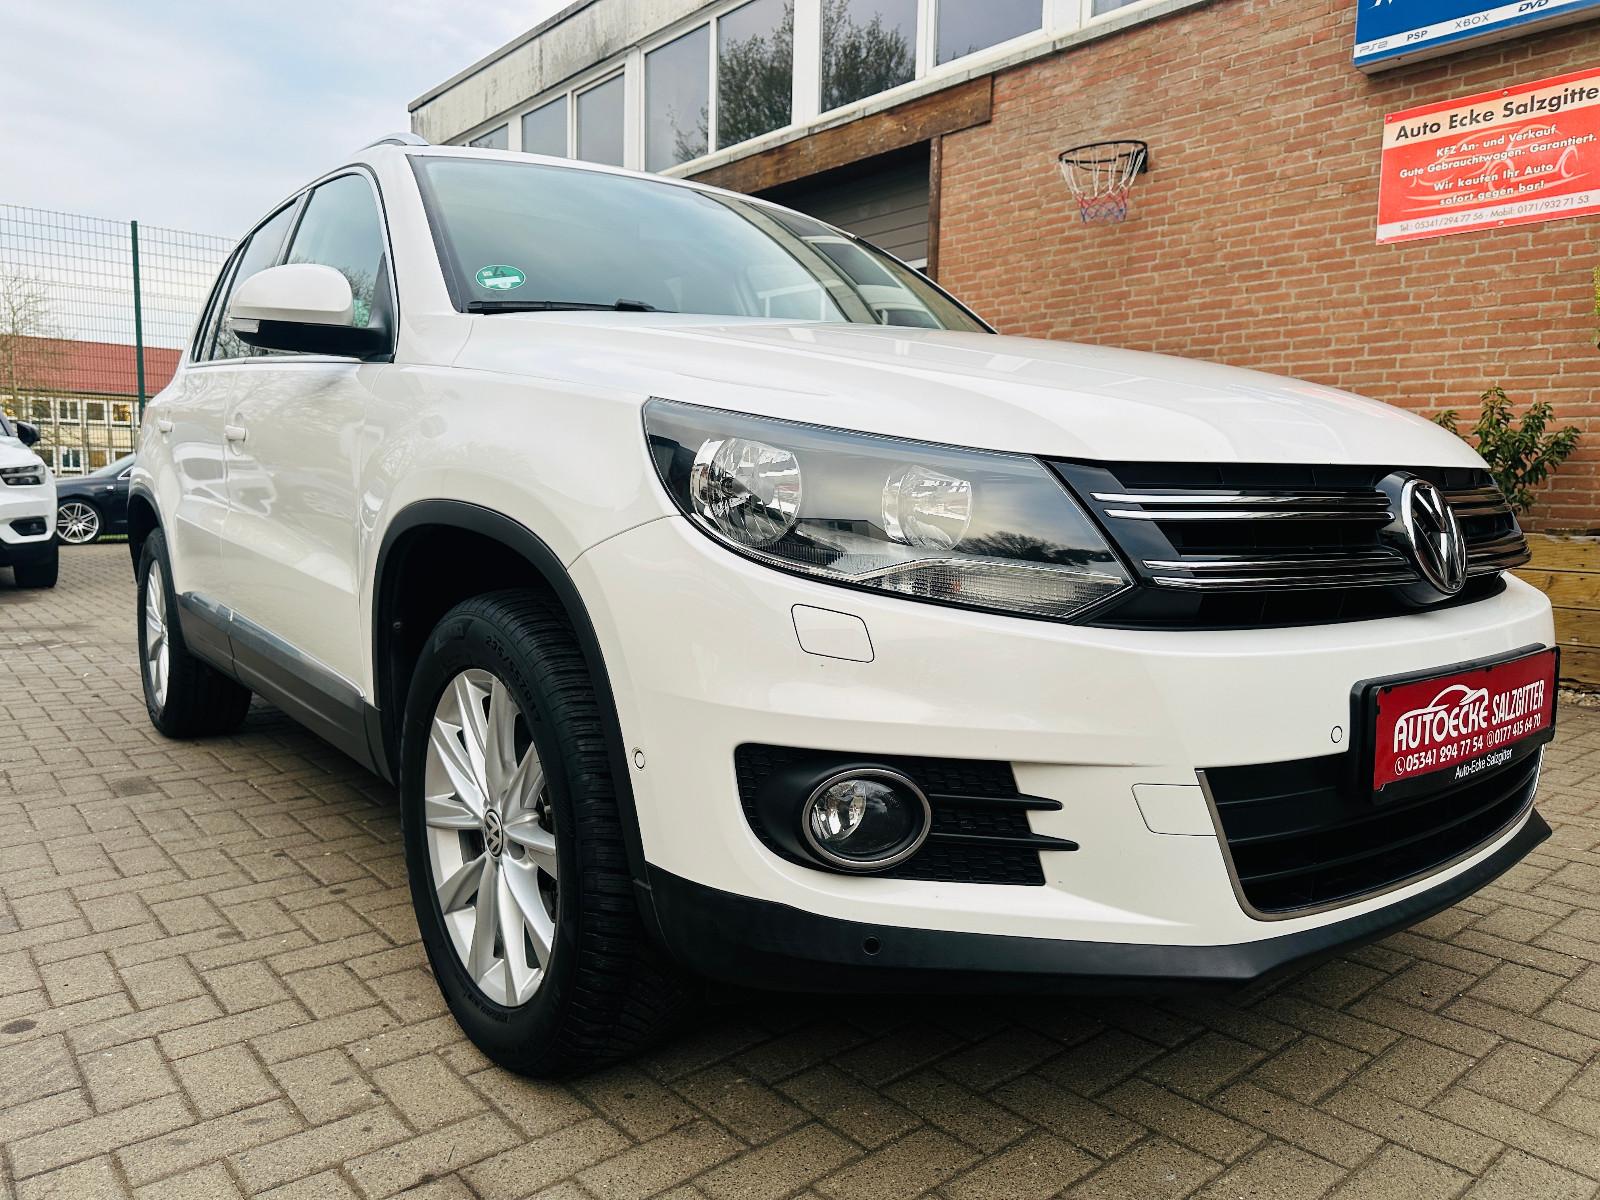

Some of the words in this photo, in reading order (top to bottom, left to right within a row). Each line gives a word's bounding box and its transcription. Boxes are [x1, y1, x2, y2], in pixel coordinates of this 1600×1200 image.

[1360, 40, 1388, 54] PS2
[1406, 30, 1428, 42] PSP
[1454, 13, 1490, 30] XBOX
[1518, 0, 1549, 12] DVD
[1395, 122, 1440, 141] Auto
[1448, 108, 1495, 129] Ecke
[1436, 145, 1457, 157] KFZ
[1460, 142, 1479, 152] An-
[1483, 134, 1504, 148] und
[1508, 124, 1557, 142] Verkauf
[1399, 167, 1424, 178] Gute
[1530, 133, 1597, 153] Garantiert.
[1434, 180, 1454, 191] Wir
[1457, 173, 1498, 187] kaufen
[1503, 168, 1520, 179] Ihr
[1524, 164, 1554, 175] Auto
[1440, 193, 1474, 206] sofort
[1478, 186, 1513, 201] gegen
[1518, 180, 1545, 193] bar!
[1517, 200, 1561, 213] 0171/932
[1563, 197, 1574, 207] 71
[1577, 195, 1589, 205] 53
[1394, 694, 1488, 753] AUTOECKE
[1492, 680, 1545, 726] SALZGITTER
[1406, 748, 1437, 772] 05341
[1440, 742, 1458, 763] 294
[1460, 738, 1471, 757] 77
[1472, 734, 1484, 752] 54
[1494, 724, 1512, 744] 0177
[1512, 720, 1524, 737] 415
[1524, 716, 1533, 733] 64
[1533, 713, 1541, 729] 70
[1454, 757, 1486, 780] Auto-Ecke
[1486, 748, 1513, 768] Salzgitter
